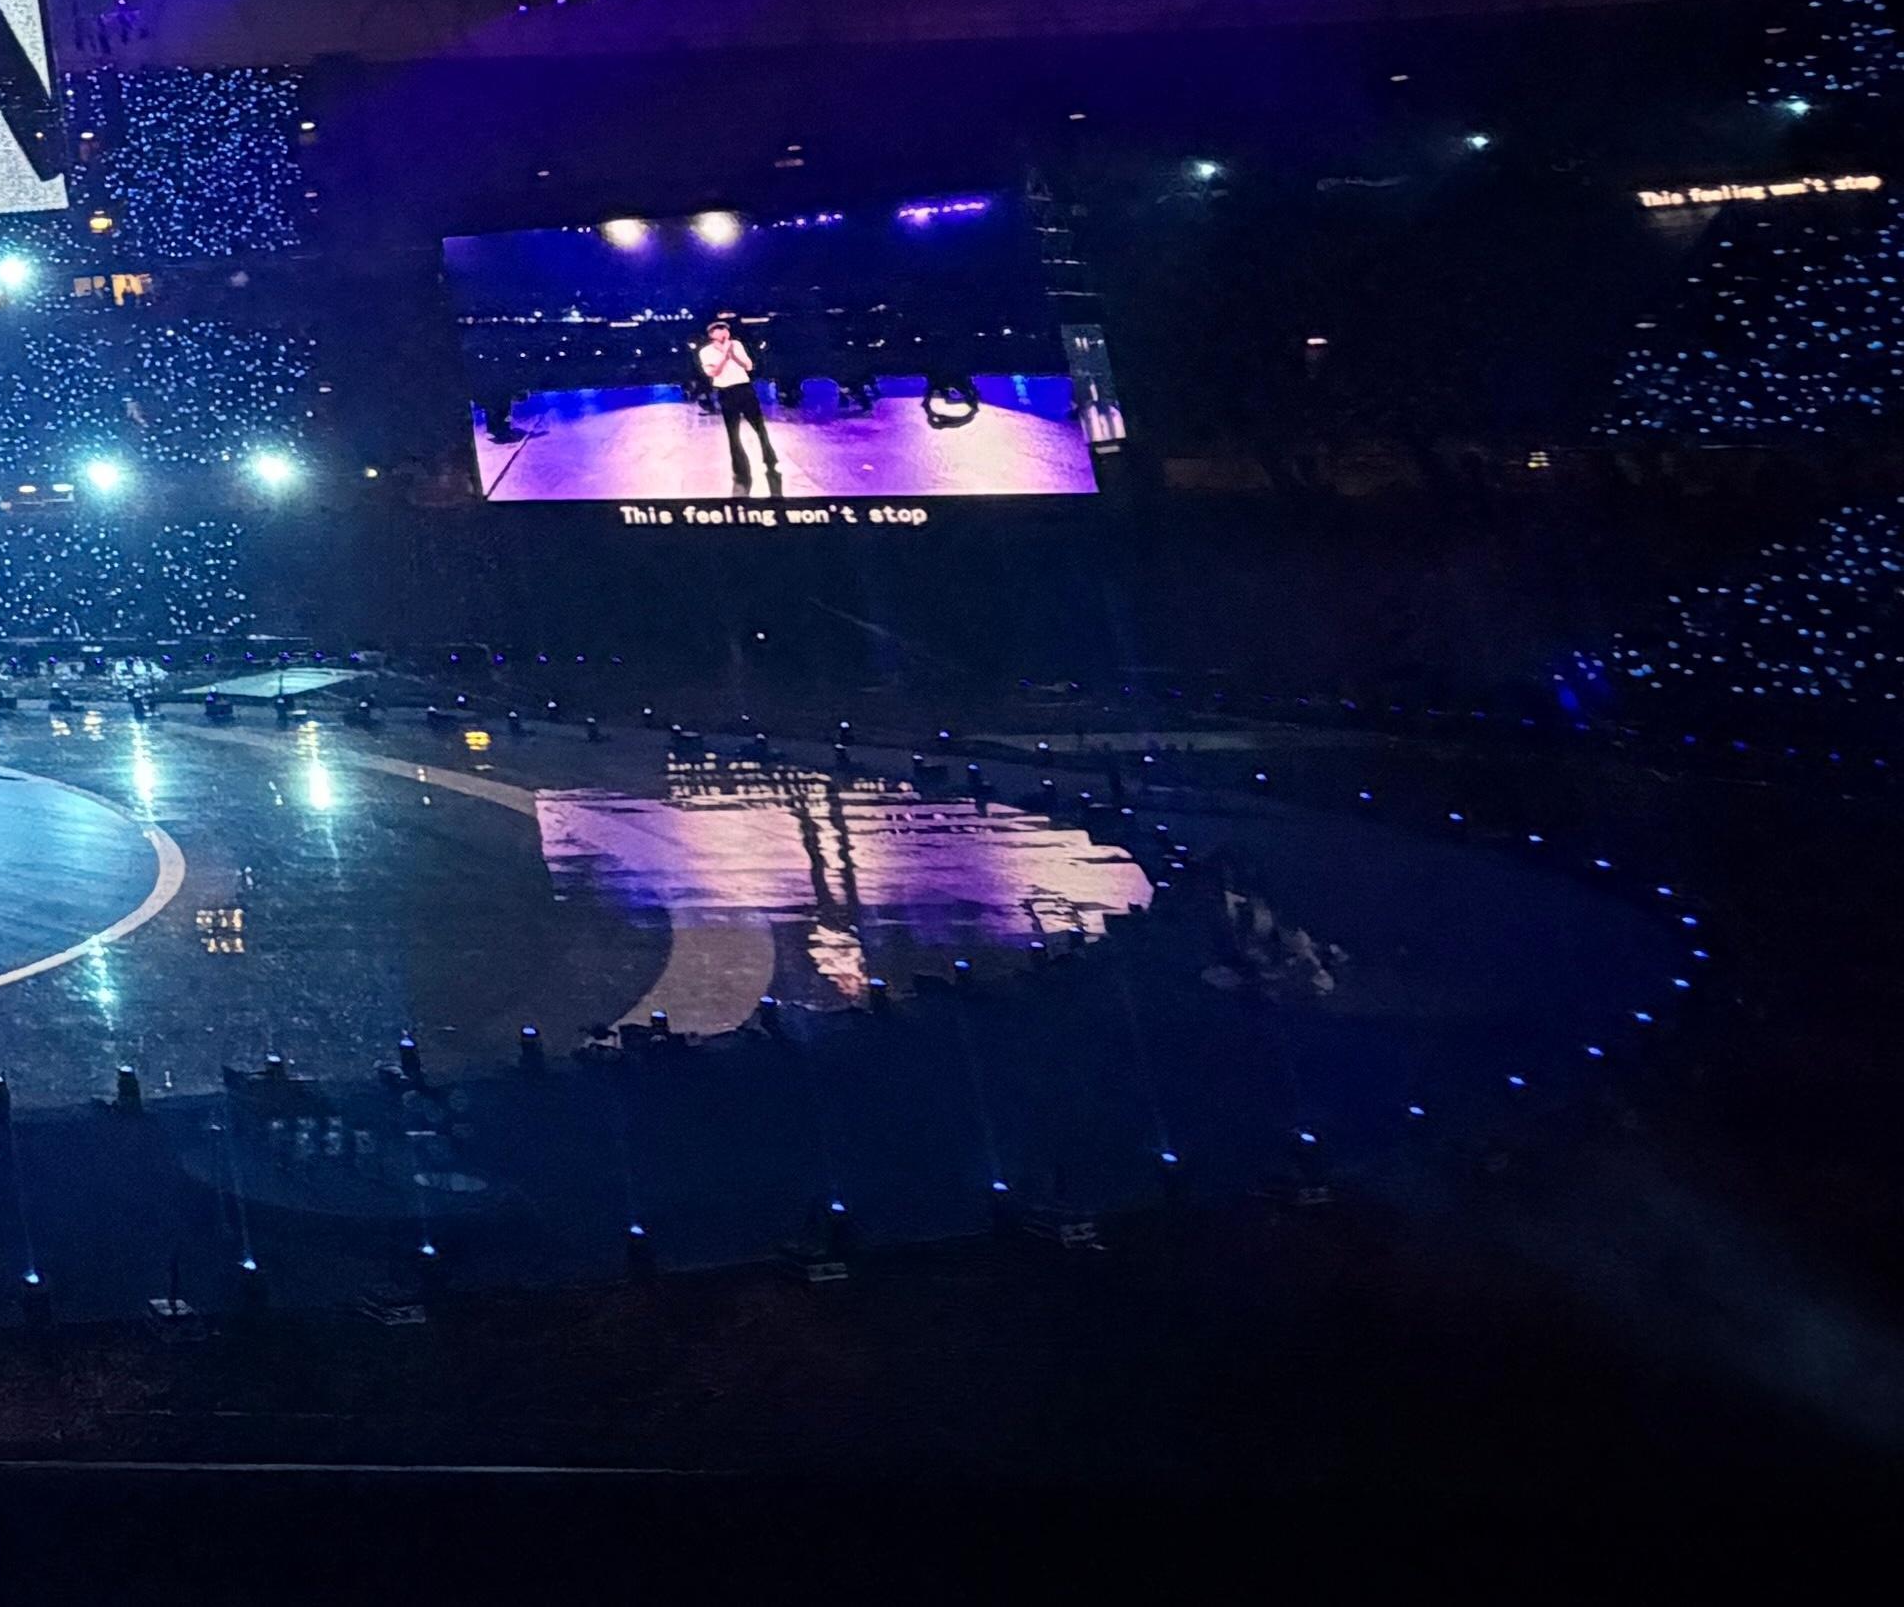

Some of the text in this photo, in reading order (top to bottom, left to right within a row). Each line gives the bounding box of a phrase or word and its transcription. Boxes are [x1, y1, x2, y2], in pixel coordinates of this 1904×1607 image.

[619, 504, 928, 527] This feeling won't stop
